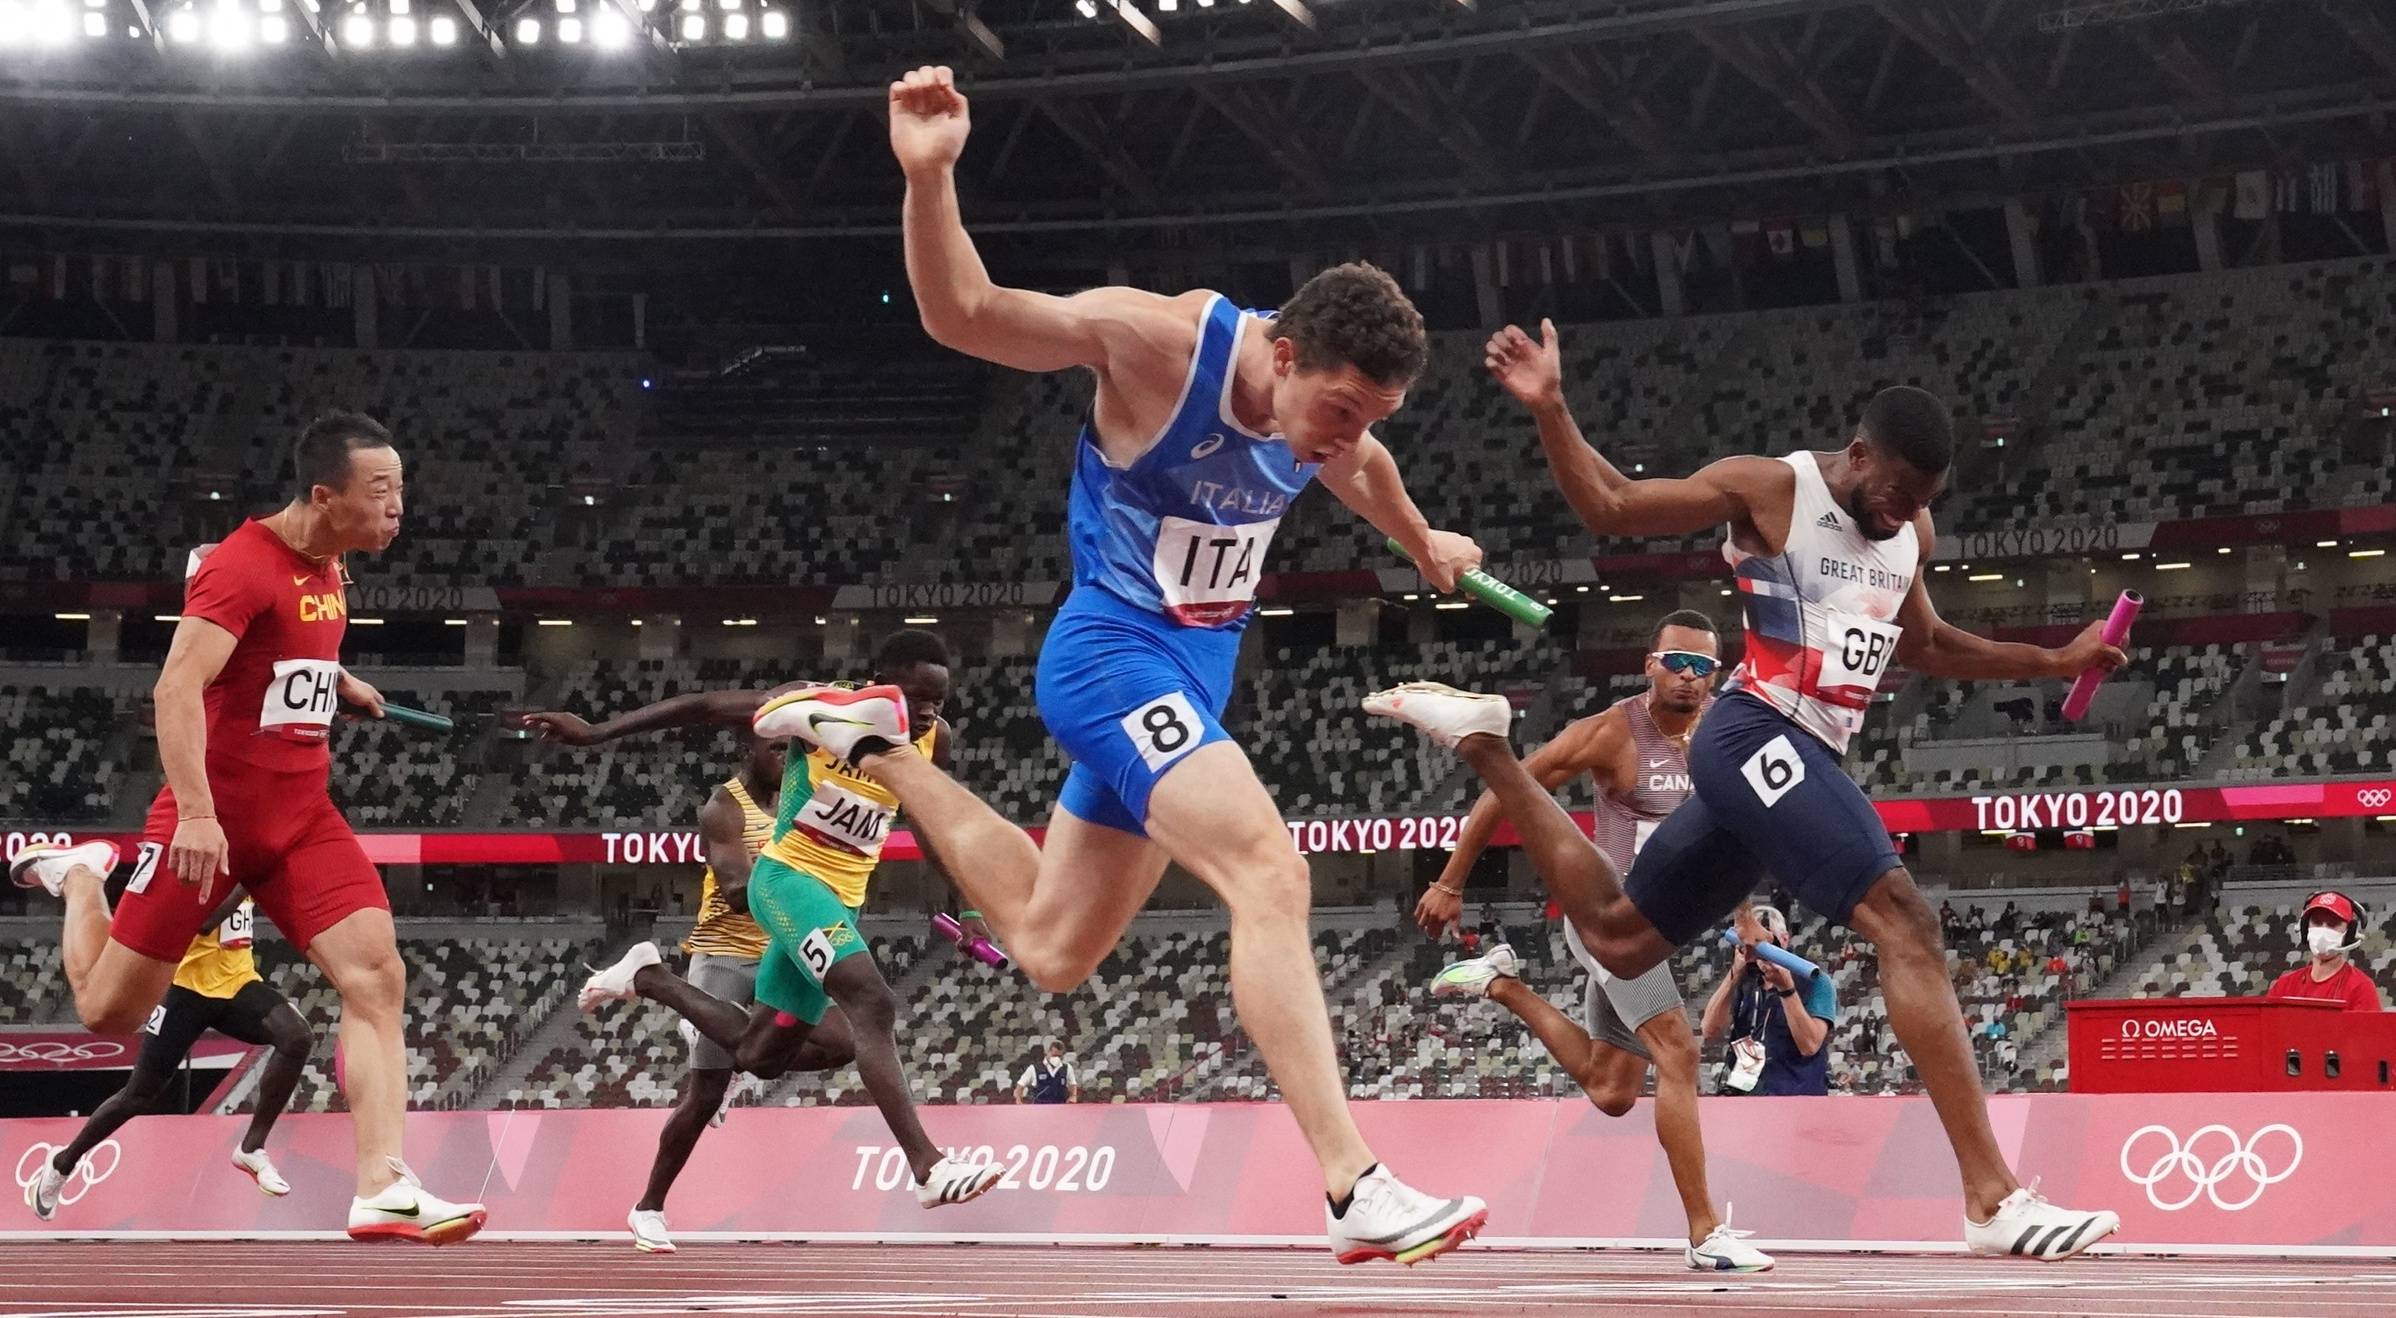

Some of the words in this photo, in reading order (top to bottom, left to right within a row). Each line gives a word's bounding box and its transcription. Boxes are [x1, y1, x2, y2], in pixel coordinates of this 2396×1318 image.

[1190, 480, 1286, 515] ITALIA
[1957, 528, 2045, 558] TOKYO
[2053, 526, 2118, 552] 2020
[1179, 535, 1255, 589] ITA
[1820, 557, 1864, 583] GREAT
[869, 582, 954, 608] TOKYO
[962, 581, 1024, 608] 2020
[1142, 705, 1189, 753] 8
[1760, 752, 1793, 791] 6
[814, 796, 886, 841] JAM
[1971, 792, 2088, 830] TOKYO
[2096, 788, 2183, 826] 2020
[1287, 818, 1392, 852] TOKYO
[130, 846, 155, 885] 7
[803, 938, 827, 973] 5
[149, 1008, 160, 1030] 2
[2144, 1019, 2217, 1037] OMEGA
[997, 1144, 1116, 1192] 2020
